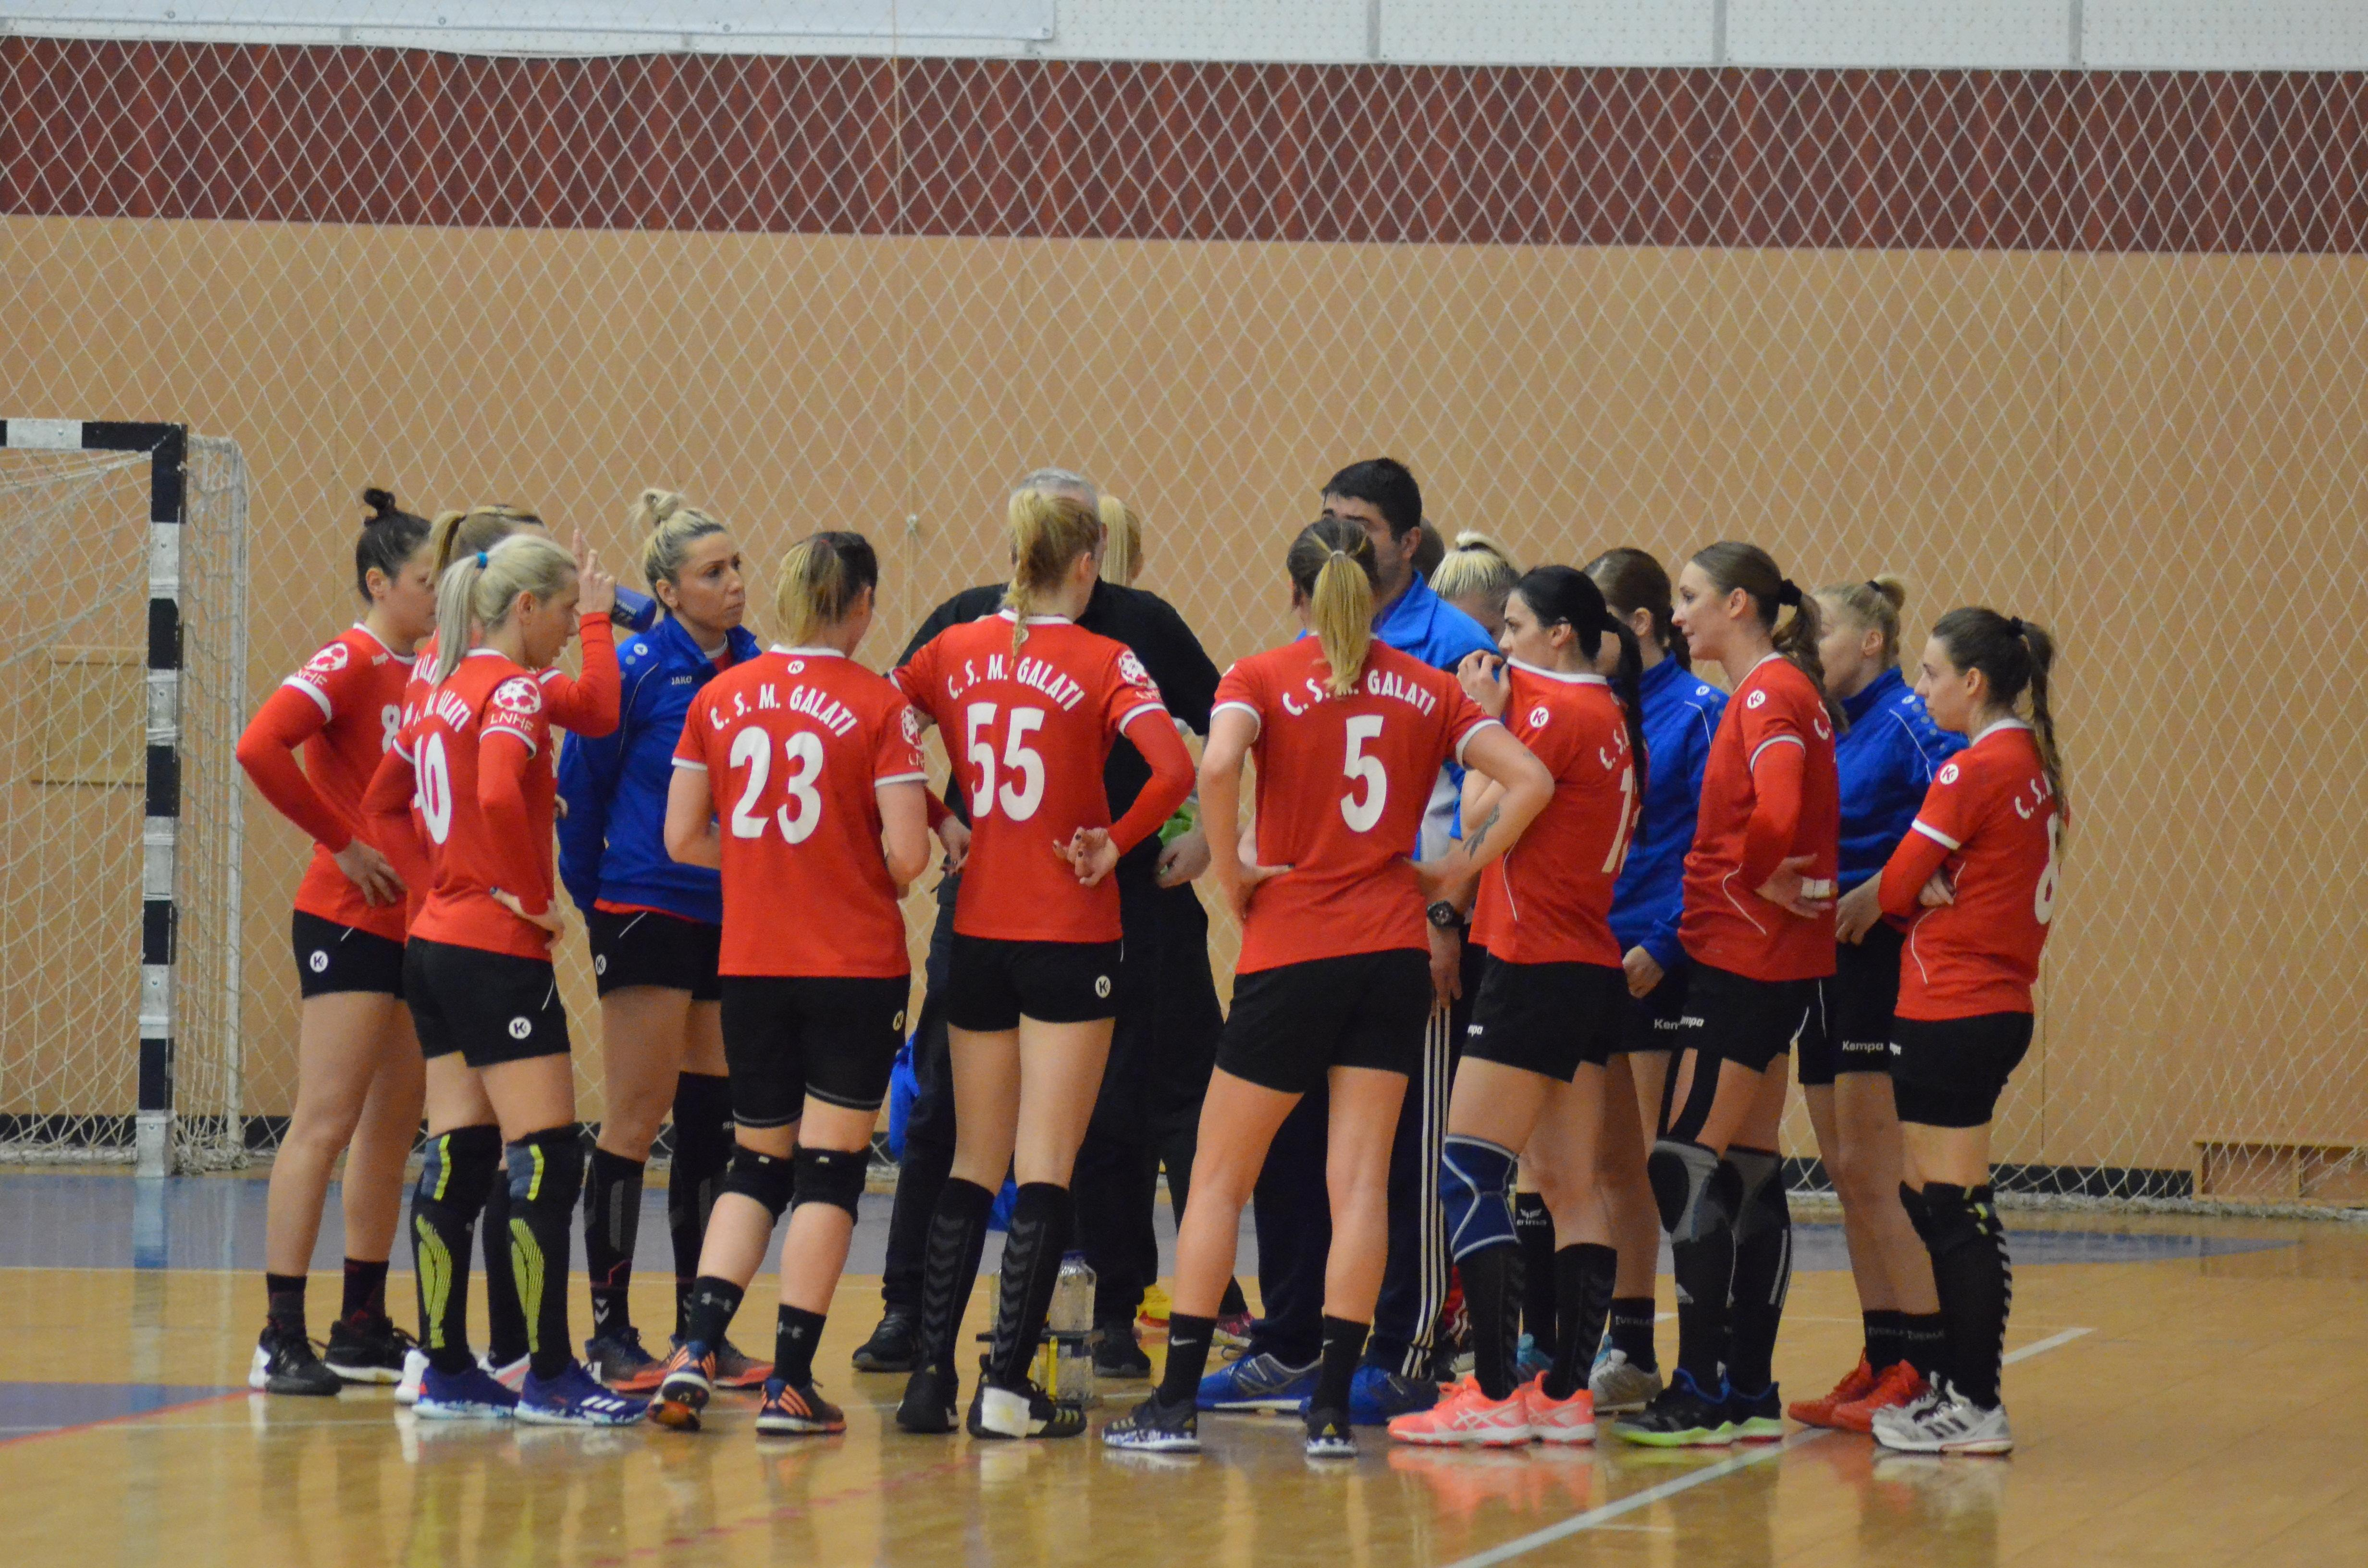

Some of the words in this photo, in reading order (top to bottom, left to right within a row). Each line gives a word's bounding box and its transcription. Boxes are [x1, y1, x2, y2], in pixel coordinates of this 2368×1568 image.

[671, 675, 692, 686] JAKO
[710, 707, 730, 730] C.
[734, 691, 752, 717] S.
[758, 683, 781, 710] M.
[789, 685, 858, 737] GALATI
[965, 659, 981, 687] S.
[987, 653, 1008, 680] M.
[1017, 657, 1085, 712] GALATI
[1282, 692, 1309, 716] C.
[1306, 678, 1331, 703] S.
[1368, 669, 1436, 717] GALATI
[490, 711, 534, 732] LNHF
[414, 731, 452, 845] 10
[730, 726, 824, 845] 23
[967, 702, 1046, 821] 55
[1340, 714, 1387, 833] 5
[1601, 763, 1641, 875] 1
[2014, 796, 2034, 819] C.
